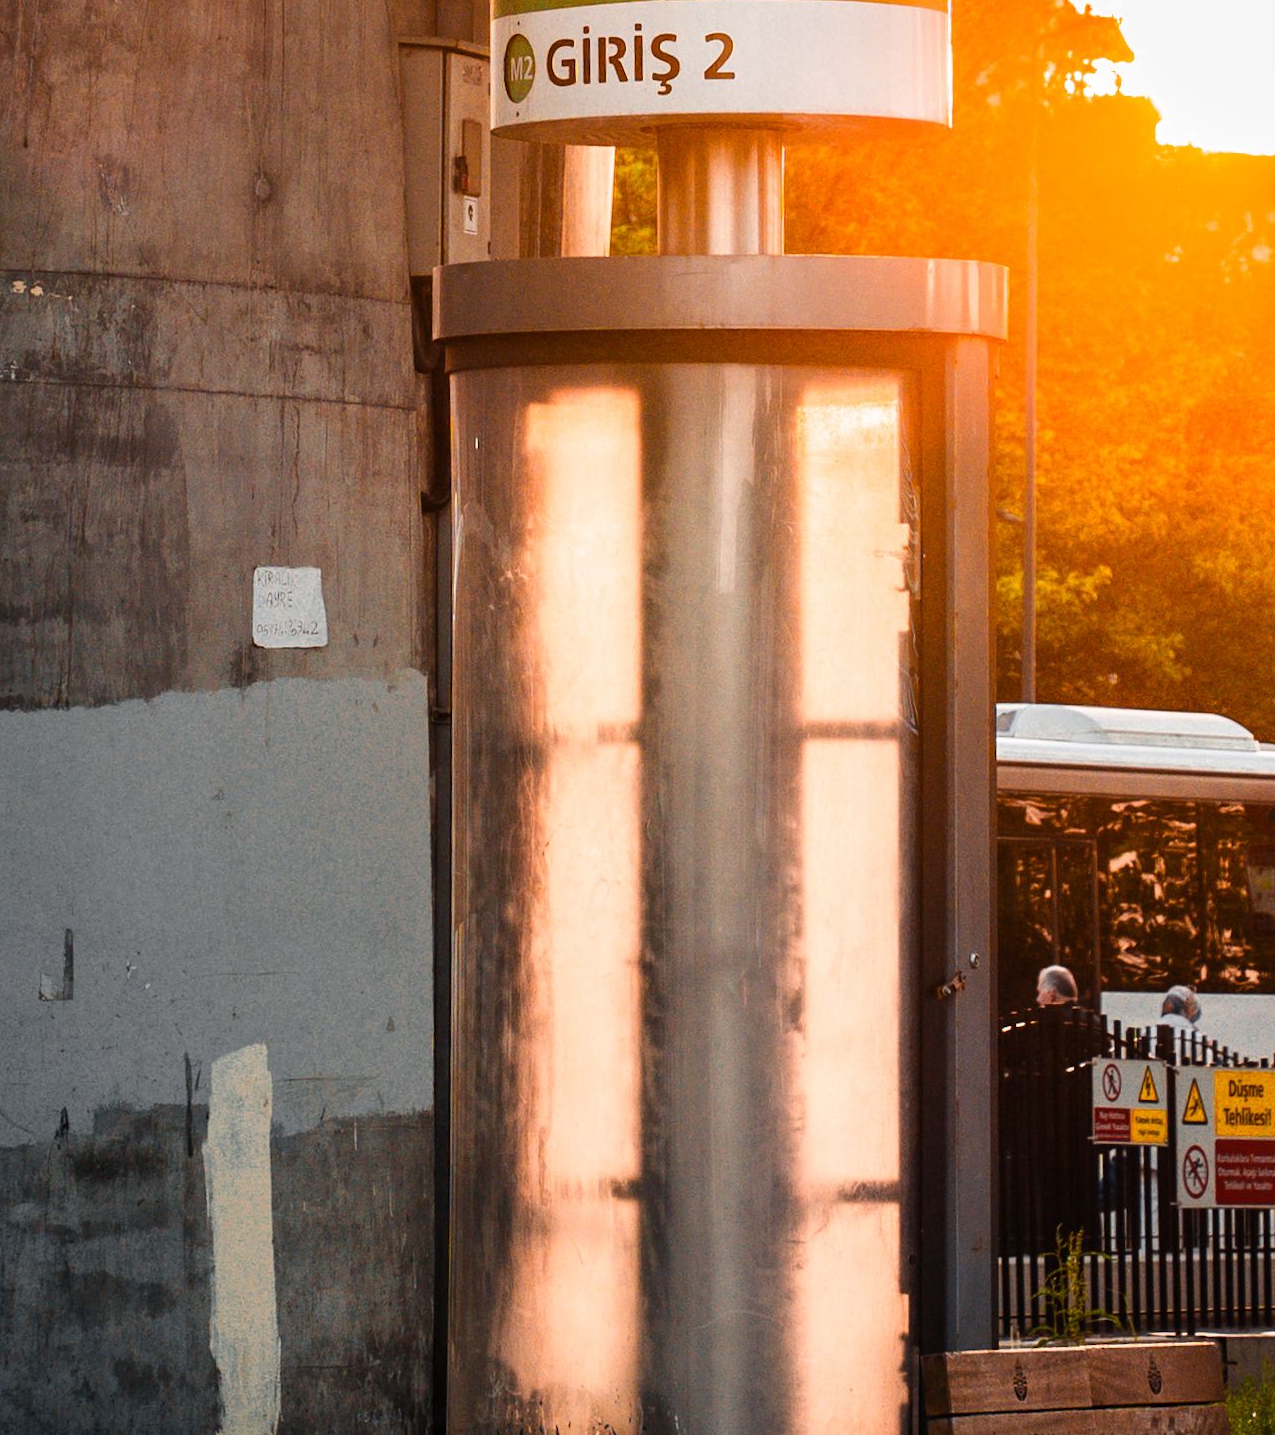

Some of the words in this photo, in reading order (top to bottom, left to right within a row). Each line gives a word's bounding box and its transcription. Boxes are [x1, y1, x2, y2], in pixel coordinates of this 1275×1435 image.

[510, 55, 534, 82] M2
[546, 23, 681, 96] GİRİŞ
[703, 32, 736, 80] 2
[1228, 1080, 1264, 1103] Düşme
[1223, 1108, 1272, 1126] Tehlikesi!
